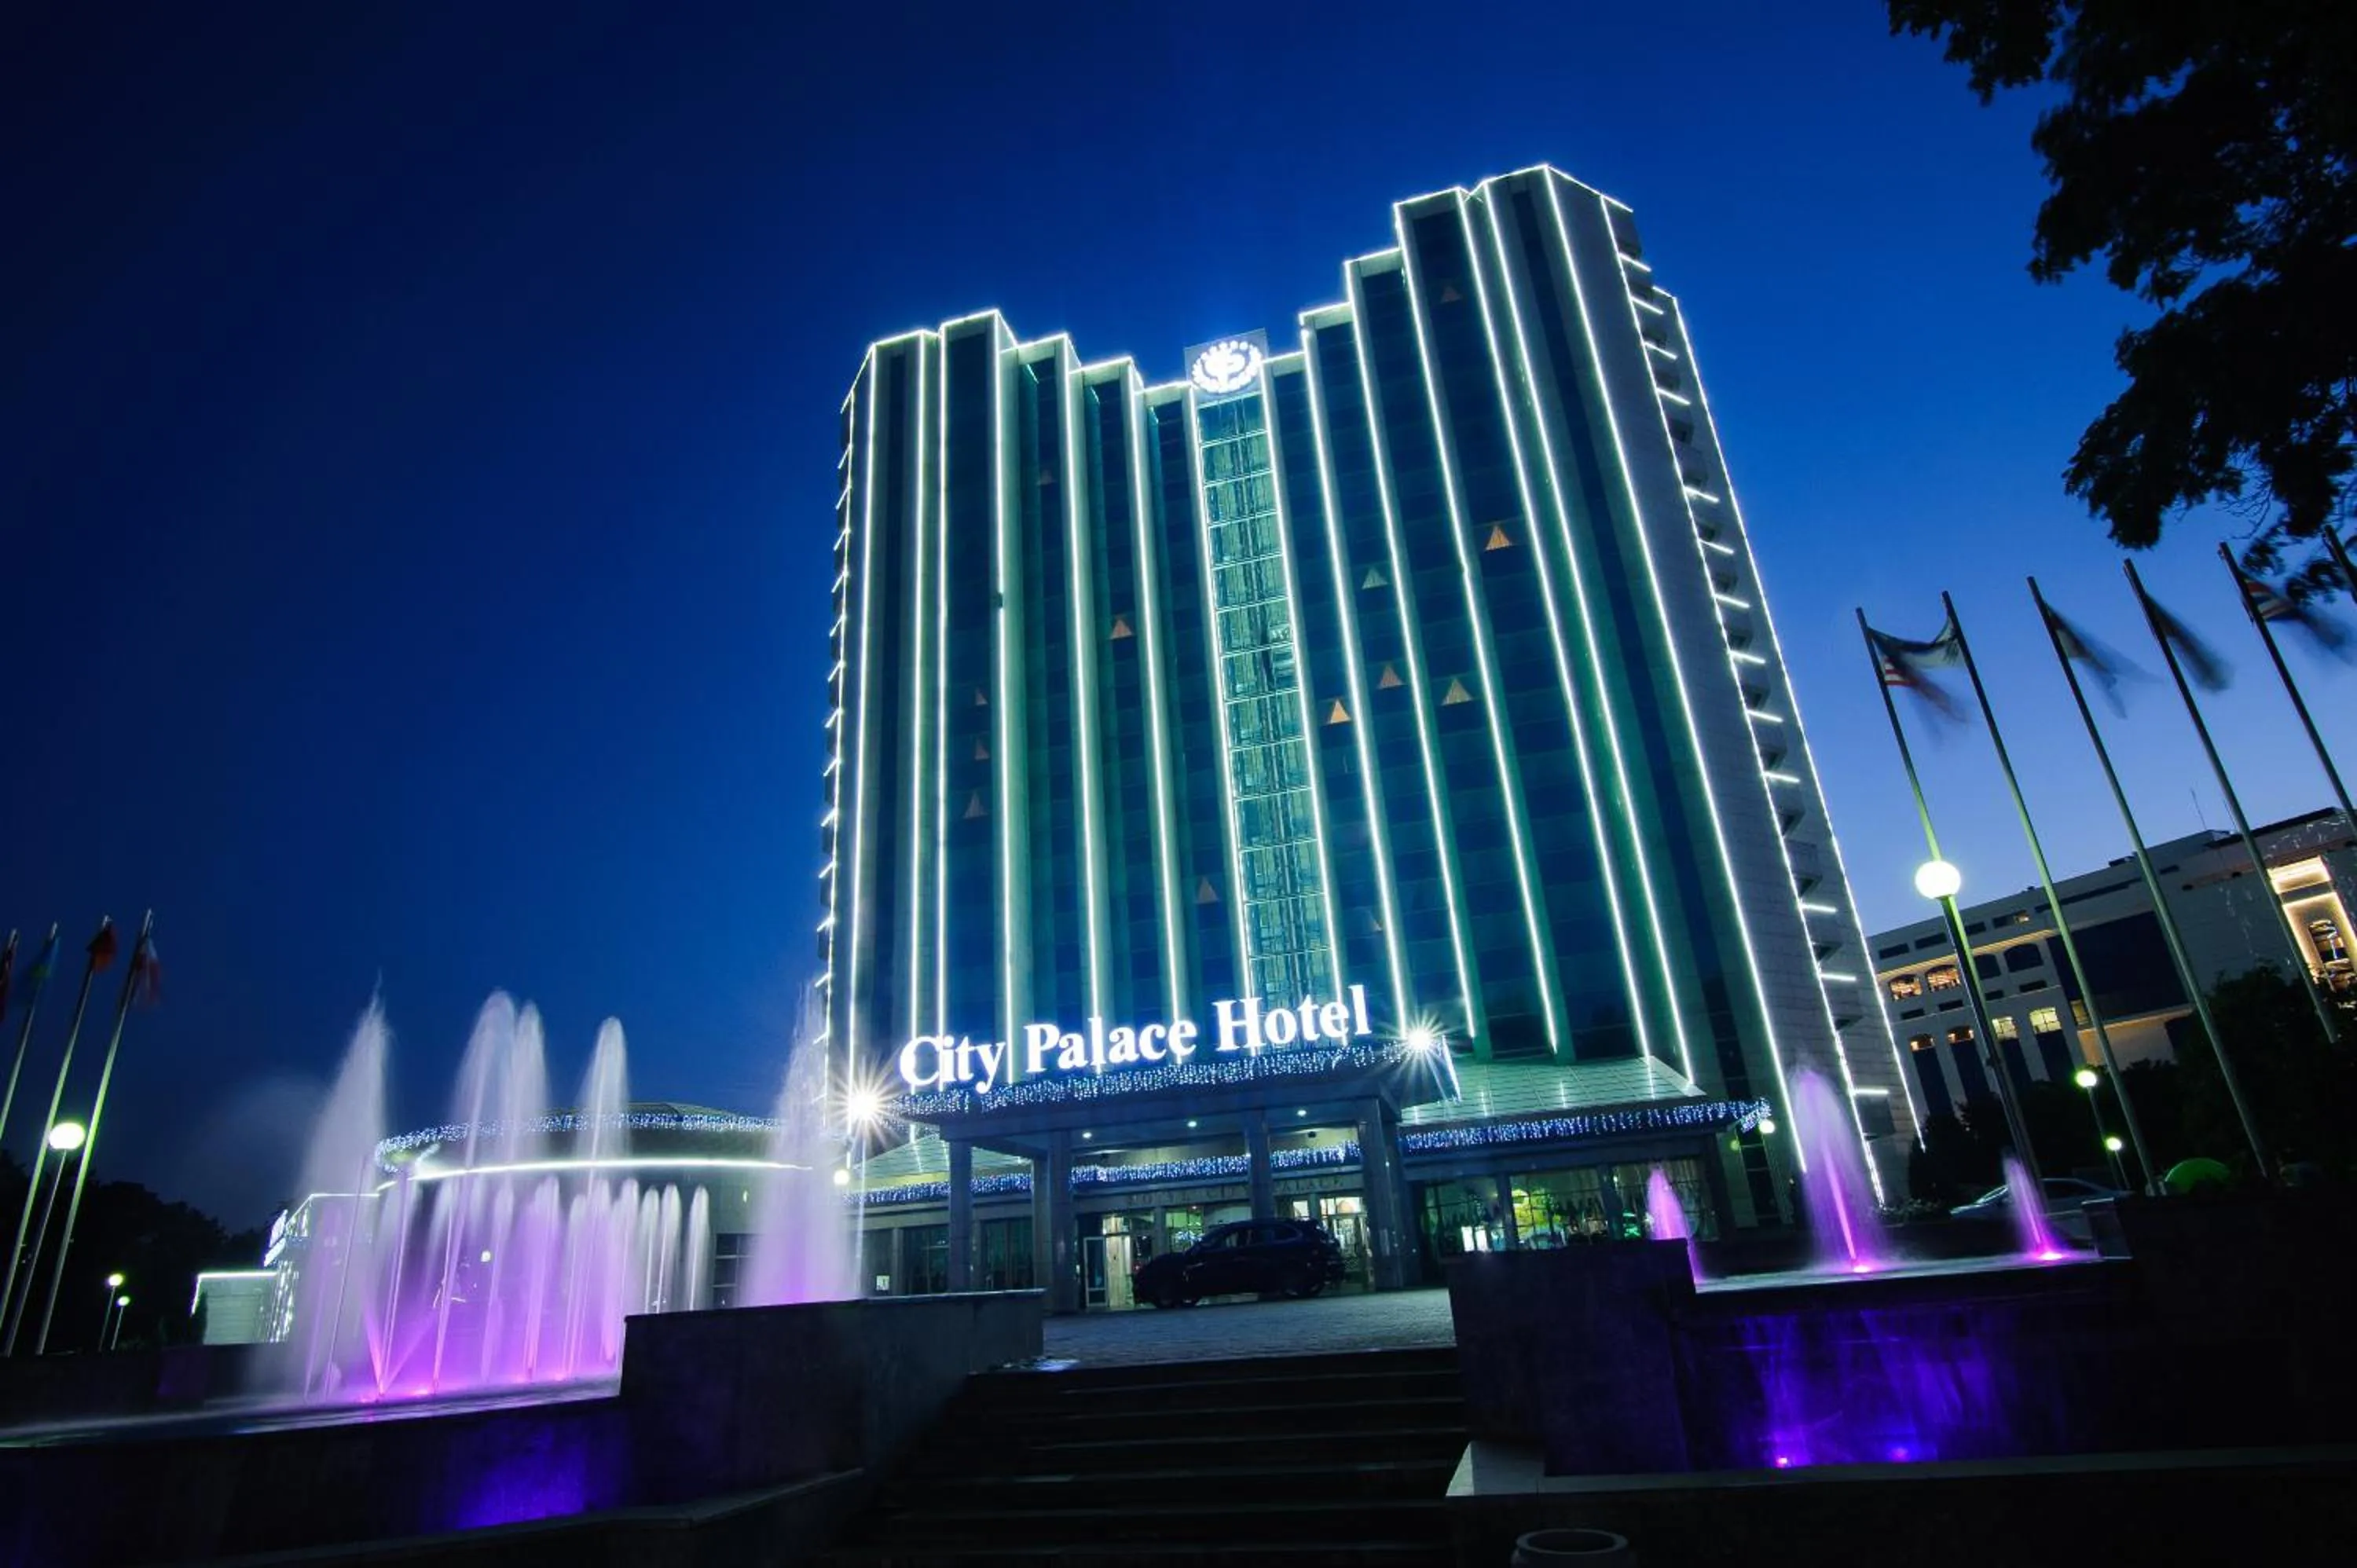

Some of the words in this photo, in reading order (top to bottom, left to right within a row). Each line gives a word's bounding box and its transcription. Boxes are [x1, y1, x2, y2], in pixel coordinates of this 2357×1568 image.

[899, 1034, 1006, 1094] City
[1023, 1017, 1198, 1073] Palace
[1211, 984, 1371, 1053] Hotel
